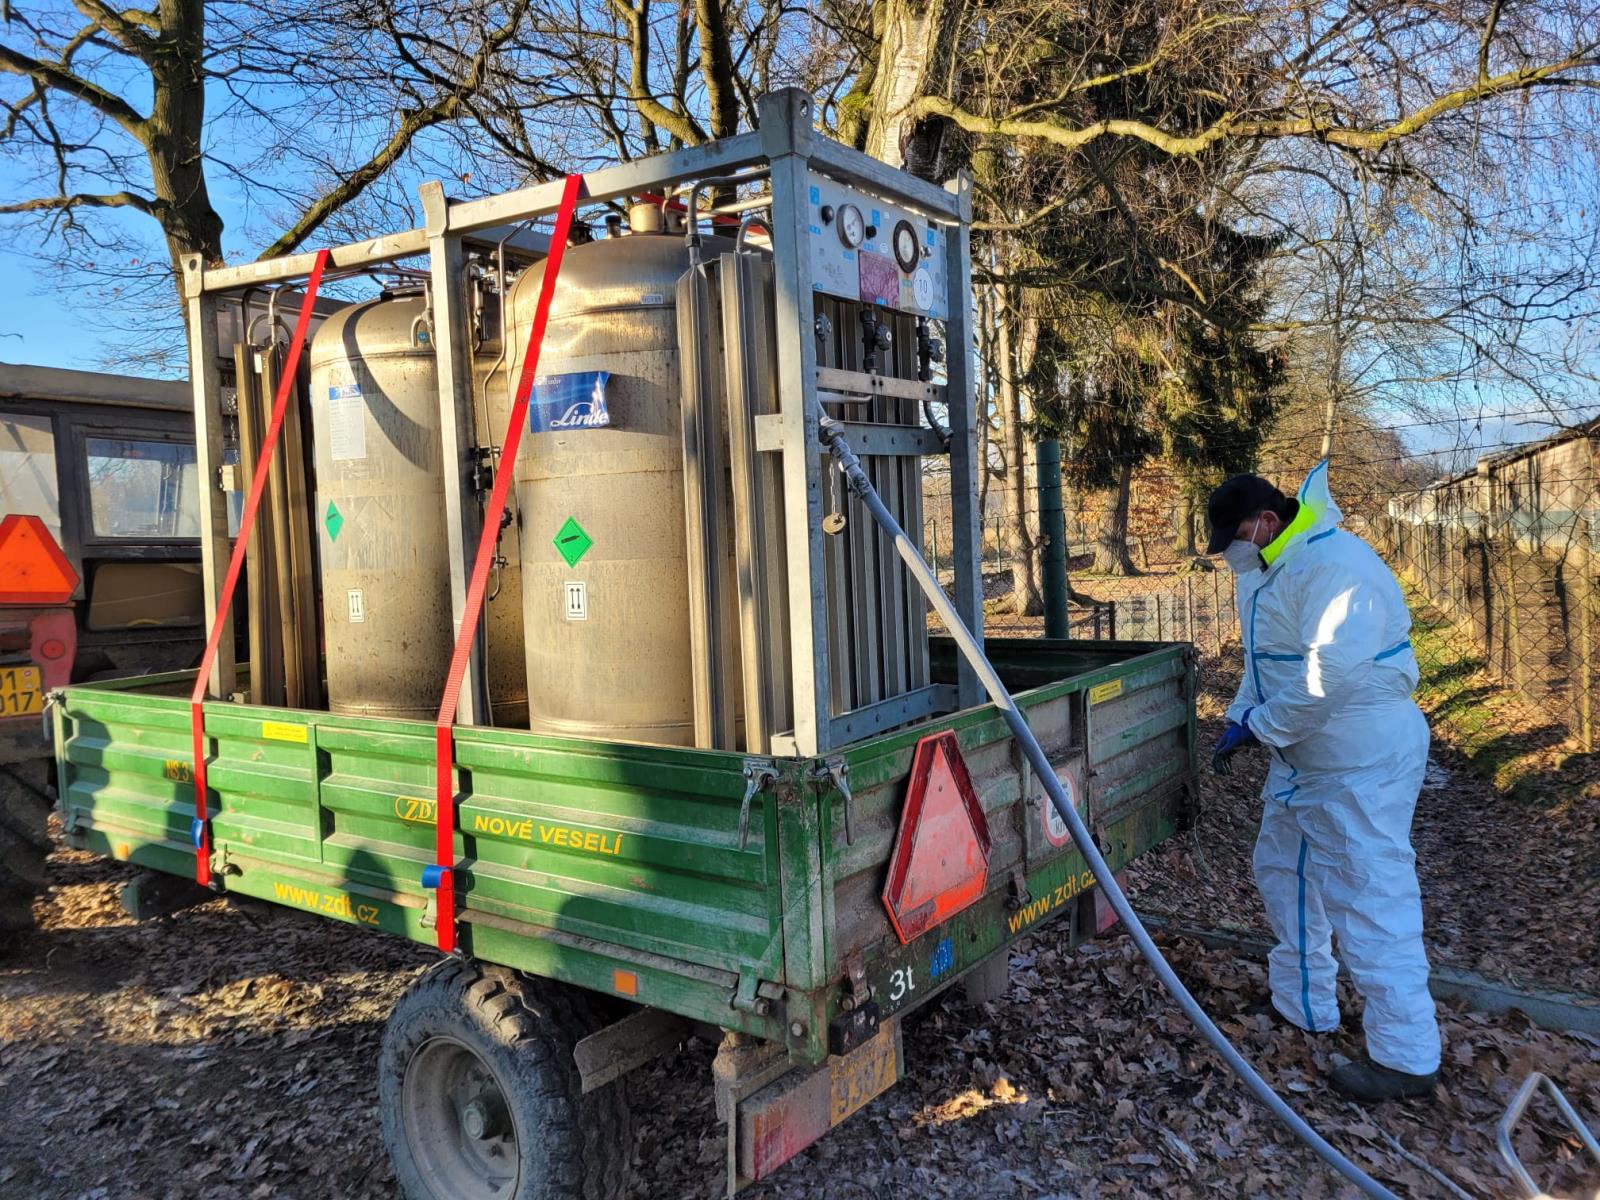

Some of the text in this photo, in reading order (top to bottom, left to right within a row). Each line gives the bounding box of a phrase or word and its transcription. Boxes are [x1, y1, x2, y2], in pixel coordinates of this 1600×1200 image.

[0, 669, 16, 691] 1
[404, 799, 437, 821] ZD
[475, 815, 624, 855] NOVÉ VESELÍ
[273, 882, 380, 925] www.zdt.cz
[1008, 869, 1097, 934] www.zdt.cz
[889, 965, 916, 1001] 3t
